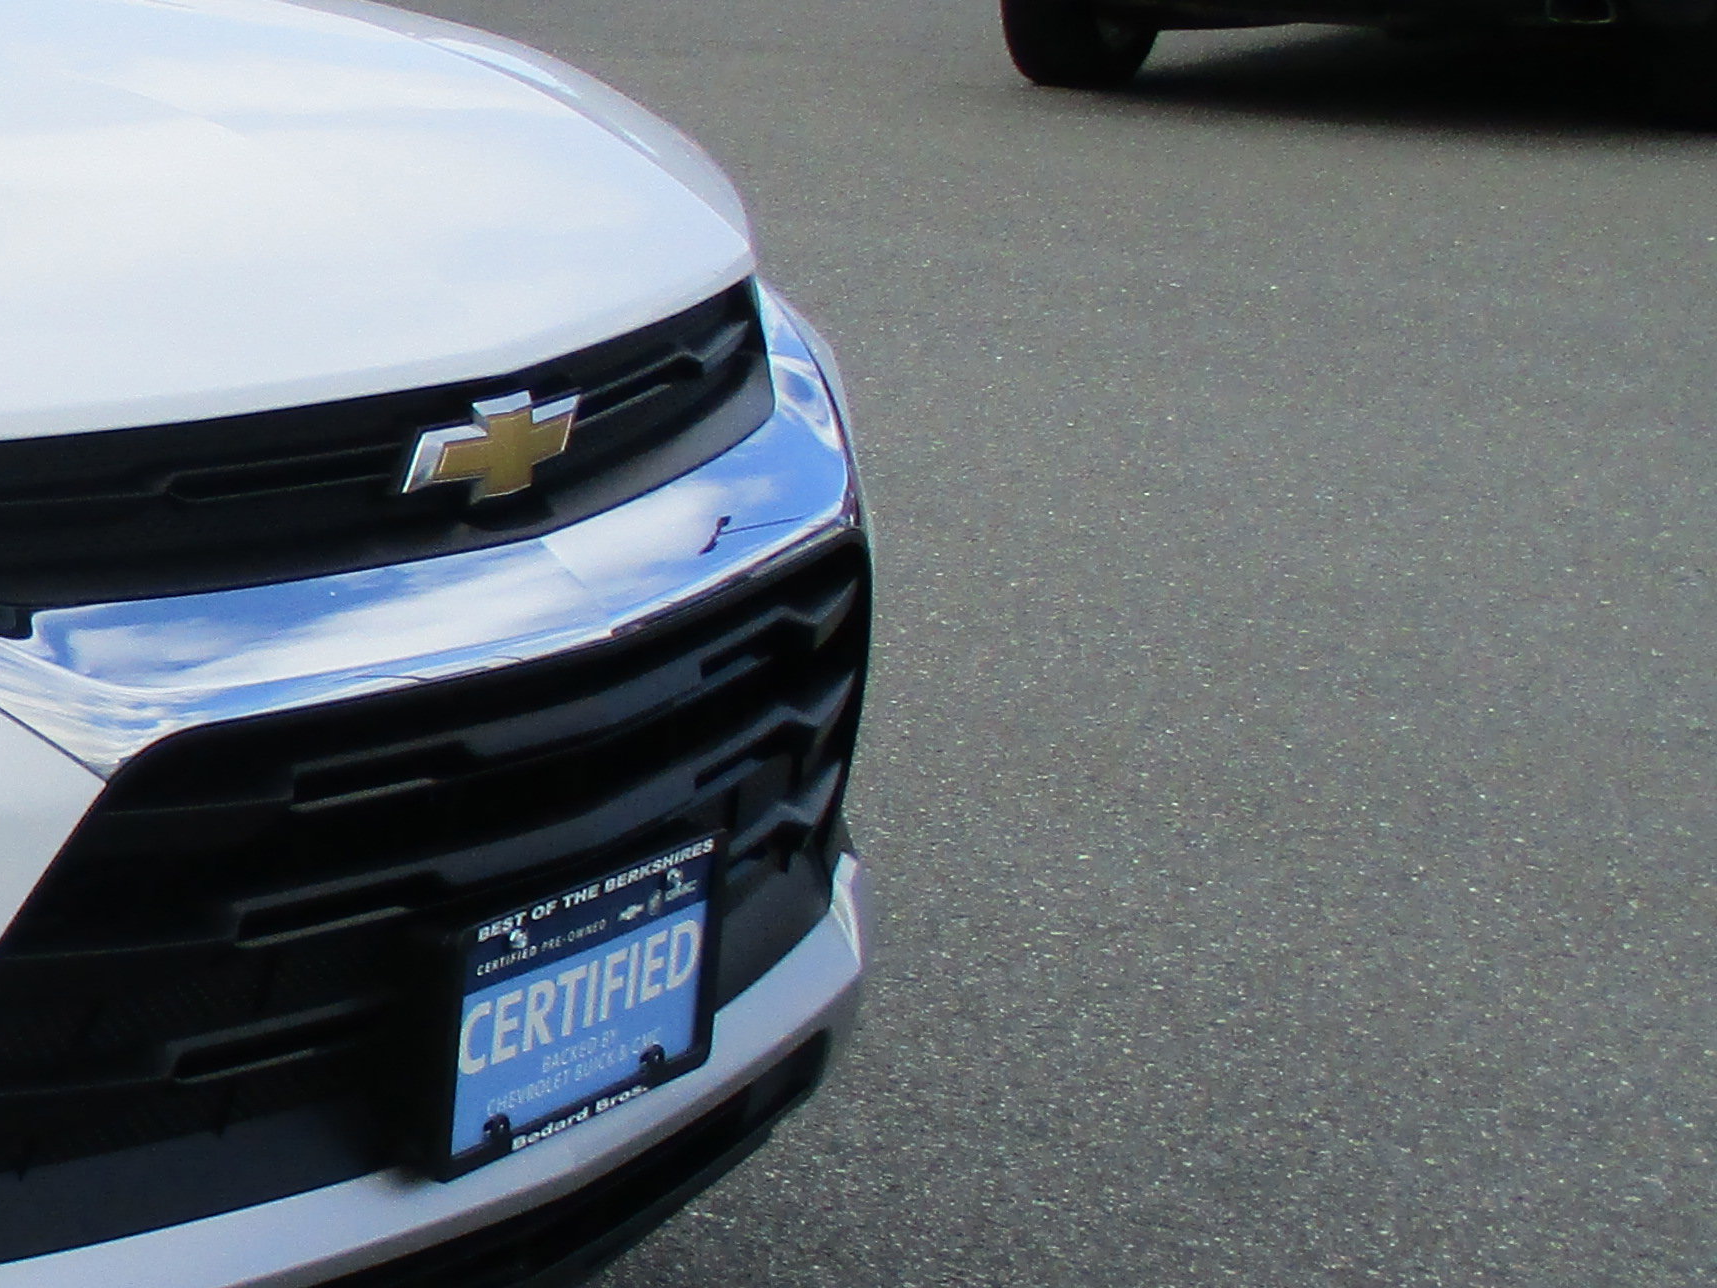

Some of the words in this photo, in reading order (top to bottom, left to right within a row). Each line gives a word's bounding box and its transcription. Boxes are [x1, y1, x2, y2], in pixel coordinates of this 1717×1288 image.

[477, 911, 527, 943] BEST
[531, 899, 559, 921] OF
[562, 883, 601, 909] THE
[604, 838, 714, 893] BERKSHIRES
[476, 945, 538, 976] CERTIFIED
[541, 919, 607, 952] PRE-OWNED
[459, 918, 702, 1075] CERTIFIED
[542, 1037, 597, 1073] BACKED
[487, 1069, 570, 1117] CHEVROLET
[512, 1106, 590, 1150] Bedard
[596, 1085, 648, 1113] Bros.
